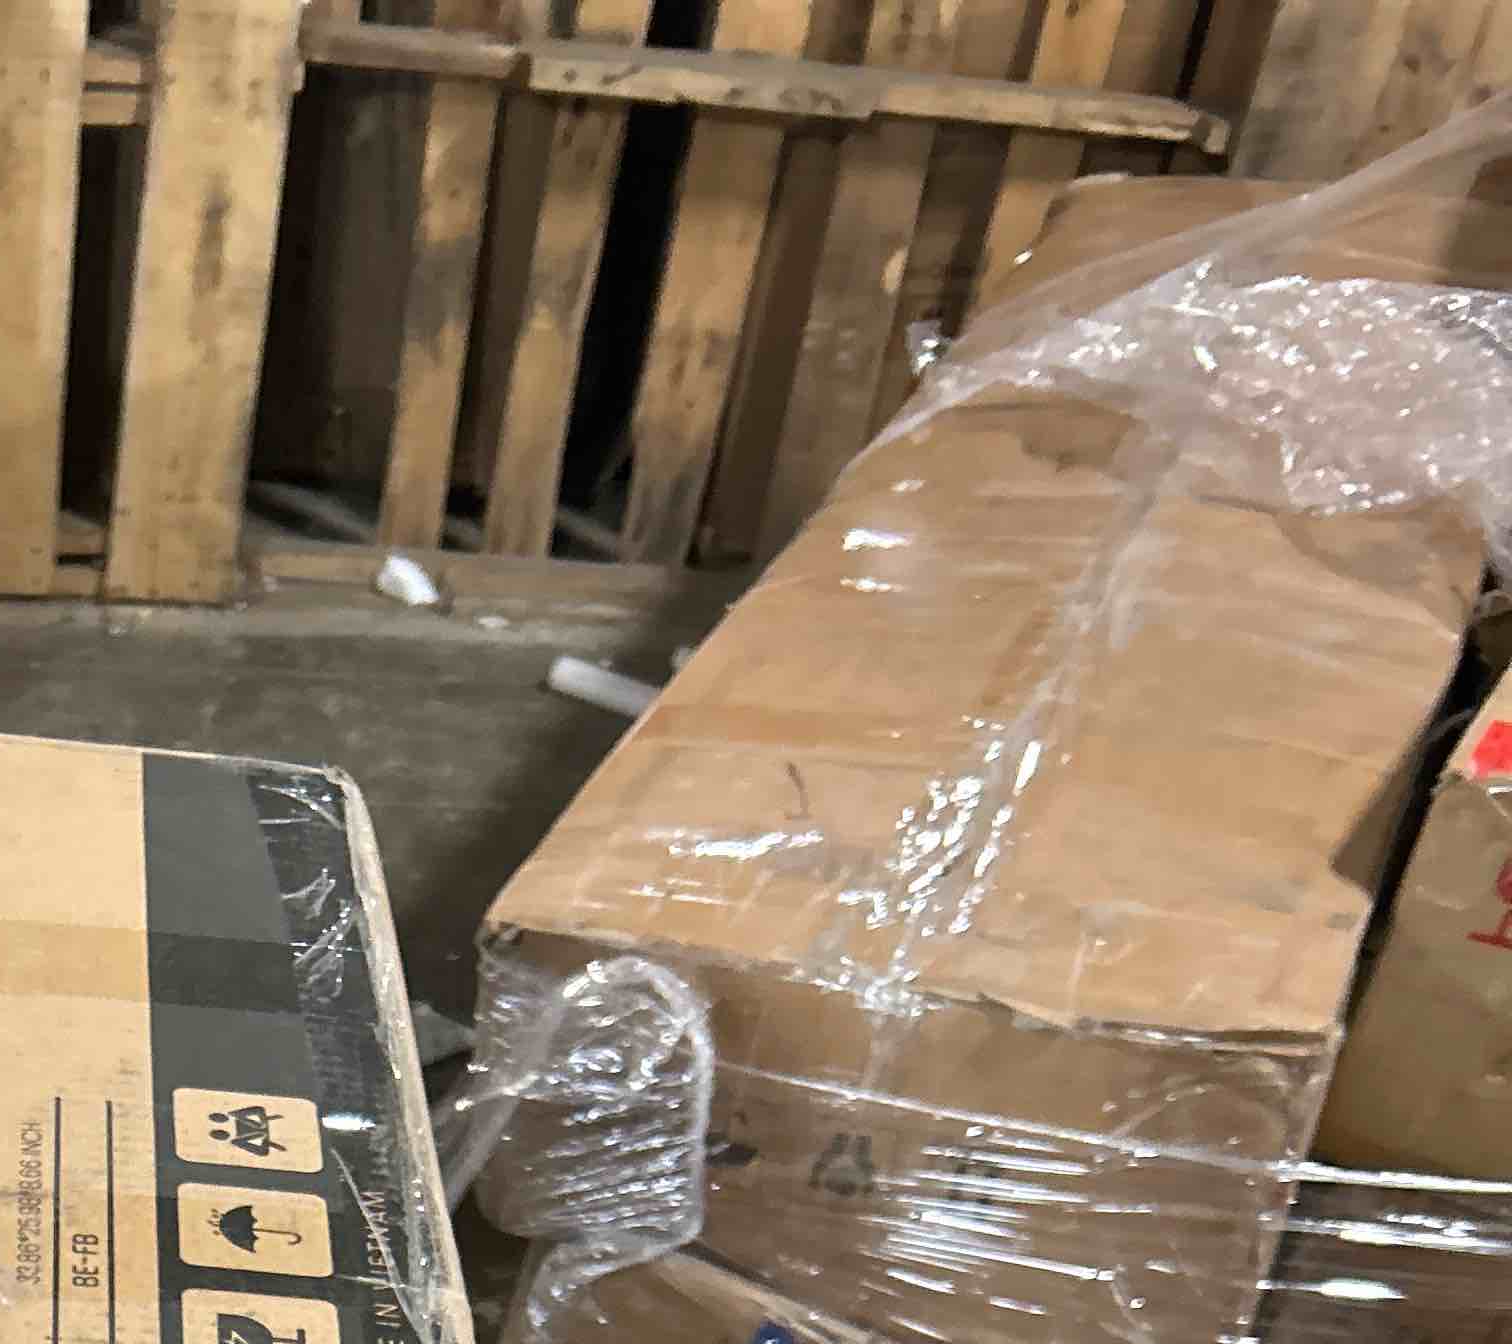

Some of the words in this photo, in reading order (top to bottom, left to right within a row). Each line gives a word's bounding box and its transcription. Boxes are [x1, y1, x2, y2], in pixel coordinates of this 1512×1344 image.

[20, 1121, 41, 1156] INCH
[72, 1234, 99, 1288] BE-FB
[362, 1190, 391, 1292] VIETNAM
[376, 1303, 400, 1328] IN
